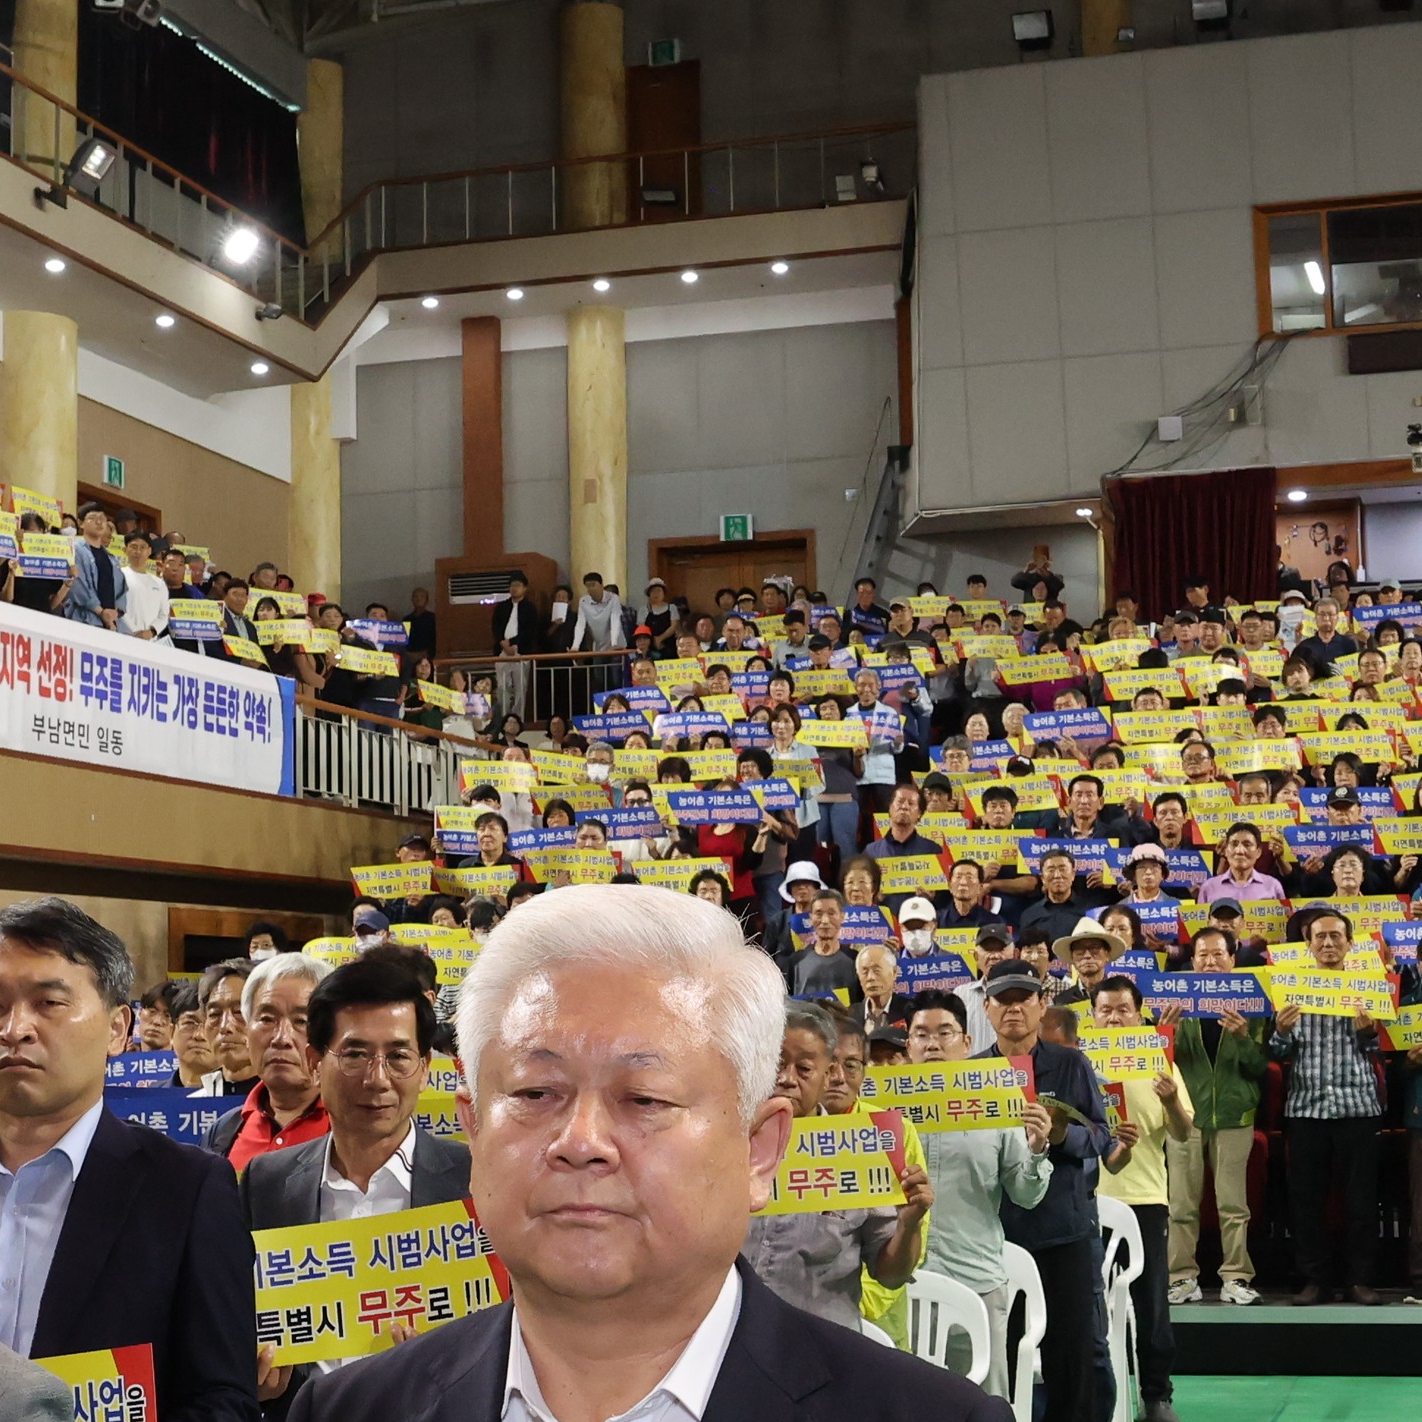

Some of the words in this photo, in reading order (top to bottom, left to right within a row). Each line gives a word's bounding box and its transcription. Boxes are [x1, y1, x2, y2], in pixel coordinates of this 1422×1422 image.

[37, 638, 75, 701] 선정!
[80, 651, 123, 713] 무주를
[127, 662, 168, 722] 지키는
[173, 674, 199, 730] 가장
[203, 683, 240, 737] 든든한
[244, 689, 272, 744] 약속!
[1032, 715, 1056, 727] 농어촌
[1059, 712, 1100, 724] 기본소득은
[32, 715, 90, 749] 부남면민
[97, 729, 124, 755] 일동
[678, 795, 704, 807] 농어촌
[707, 793, 751, 806] 기본소득은
[1223, 811, 1255, 822] 기본소득
[972, 834, 1002, 846] 기본소득
[1296, 831, 1327, 842] 농어촌
[553, 854, 582, 865] 기본소득
[579, 867, 605, 878] 무주로
[403, 880, 429, 893] 무주로
[1181, 911, 1208, 922] 농어촌
[1249, 906, 1290, 916] 시범사업을
[1245, 921, 1276, 932] 무주로
[429, 948, 453, 960] 농어촌
[1271, 950, 1299, 962] 농어촌
[1151, 979, 1189, 993] 농어촌
[1193, 977, 1255, 993] 기본소득은
[1302, 975, 1343, 990] 기본소득
[1347, 979, 1396, 994] 시범사업을
[1284, 993, 1336, 1009] 자연특별시
[1339, 996, 1375, 1011] 무주로
[1115, 1032, 1169, 1050] 시범사업을
[1109, 1056, 1147, 1073] 무주로
[1151, 1055, 1165, 1071] !!!
[884, 1073, 946, 1096] 기본소득
[952, 1067, 1028, 1092] 시범사업을
[946, 1099, 1001, 1121] 무주로
[796, 1126, 897, 1158] 시범사업을
[787, 1168, 861, 1200] 무주로
[869, 1167, 892, 1194] !!!
[356, 1284, 455, 1335] 무주로
